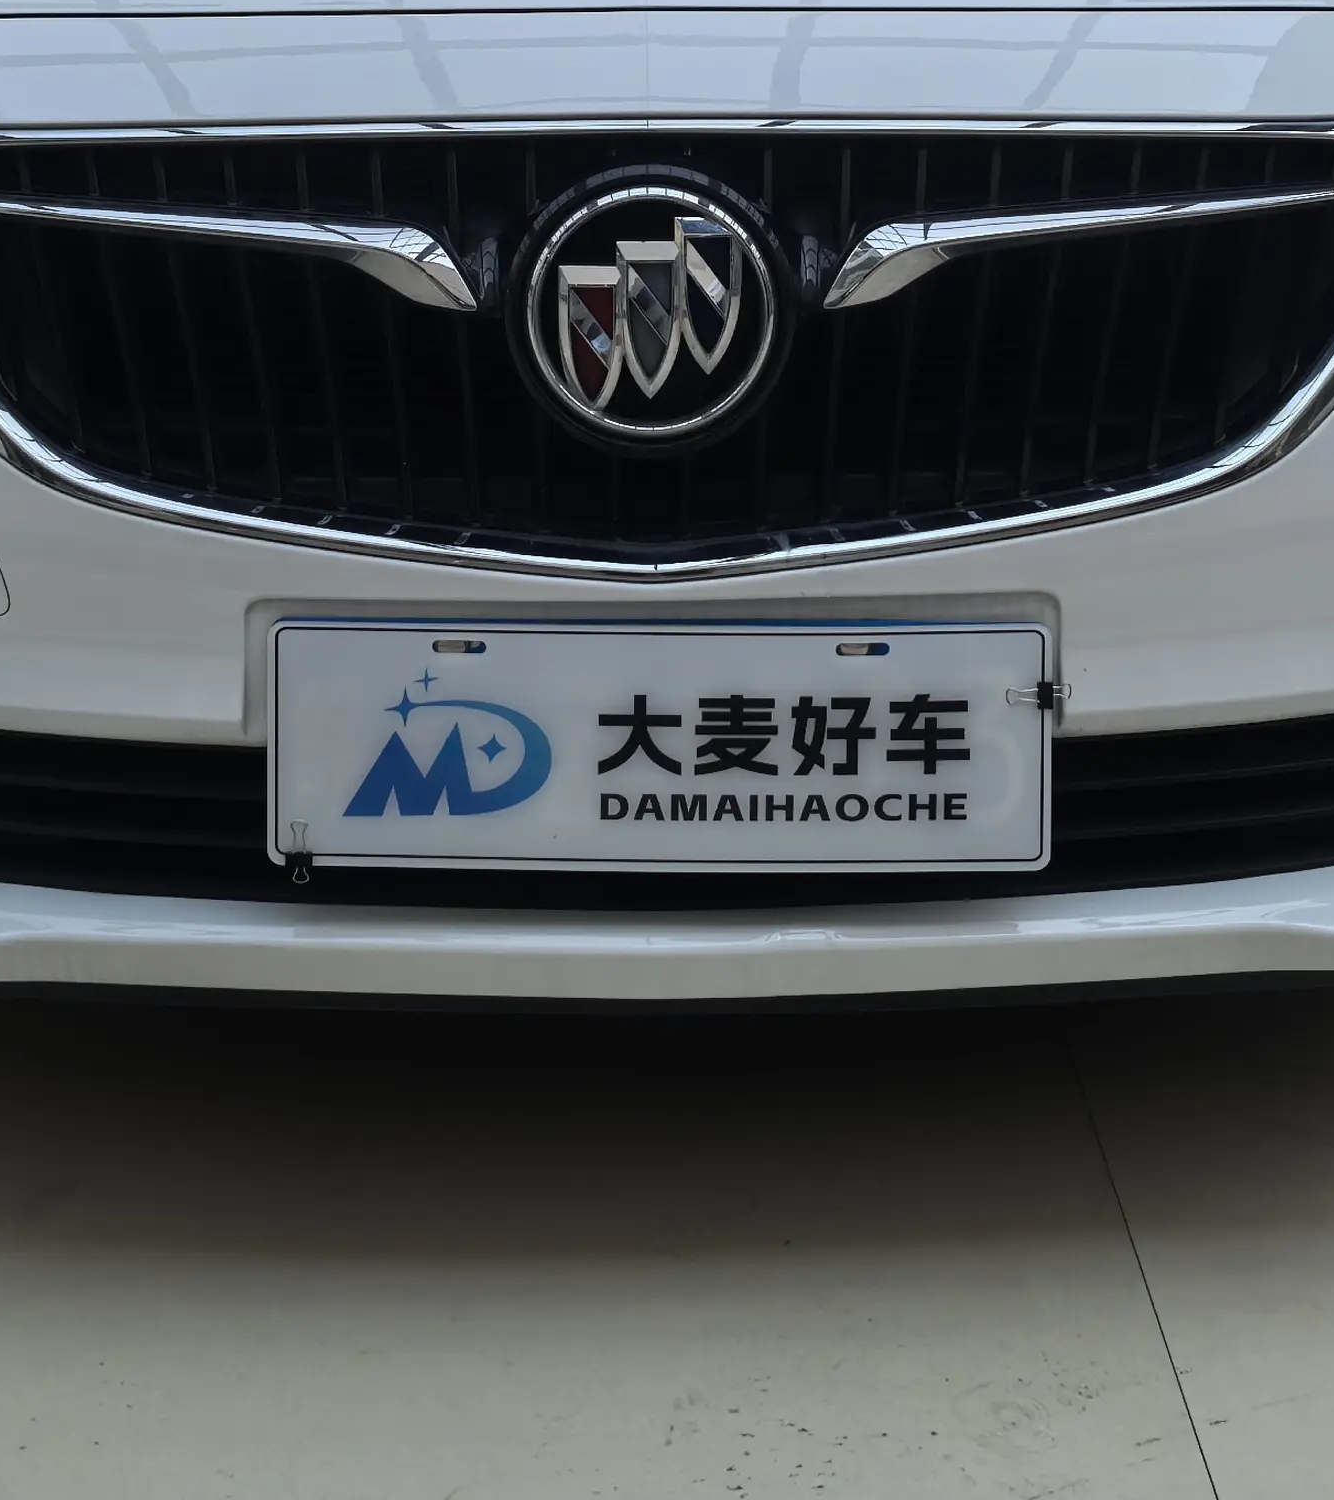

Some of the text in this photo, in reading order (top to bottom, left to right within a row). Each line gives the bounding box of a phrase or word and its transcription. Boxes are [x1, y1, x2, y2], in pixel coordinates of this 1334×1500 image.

[598, 694, 971, 777] 大麦好车
[599, 793, 969, 824] DAMAIHAOCHE
